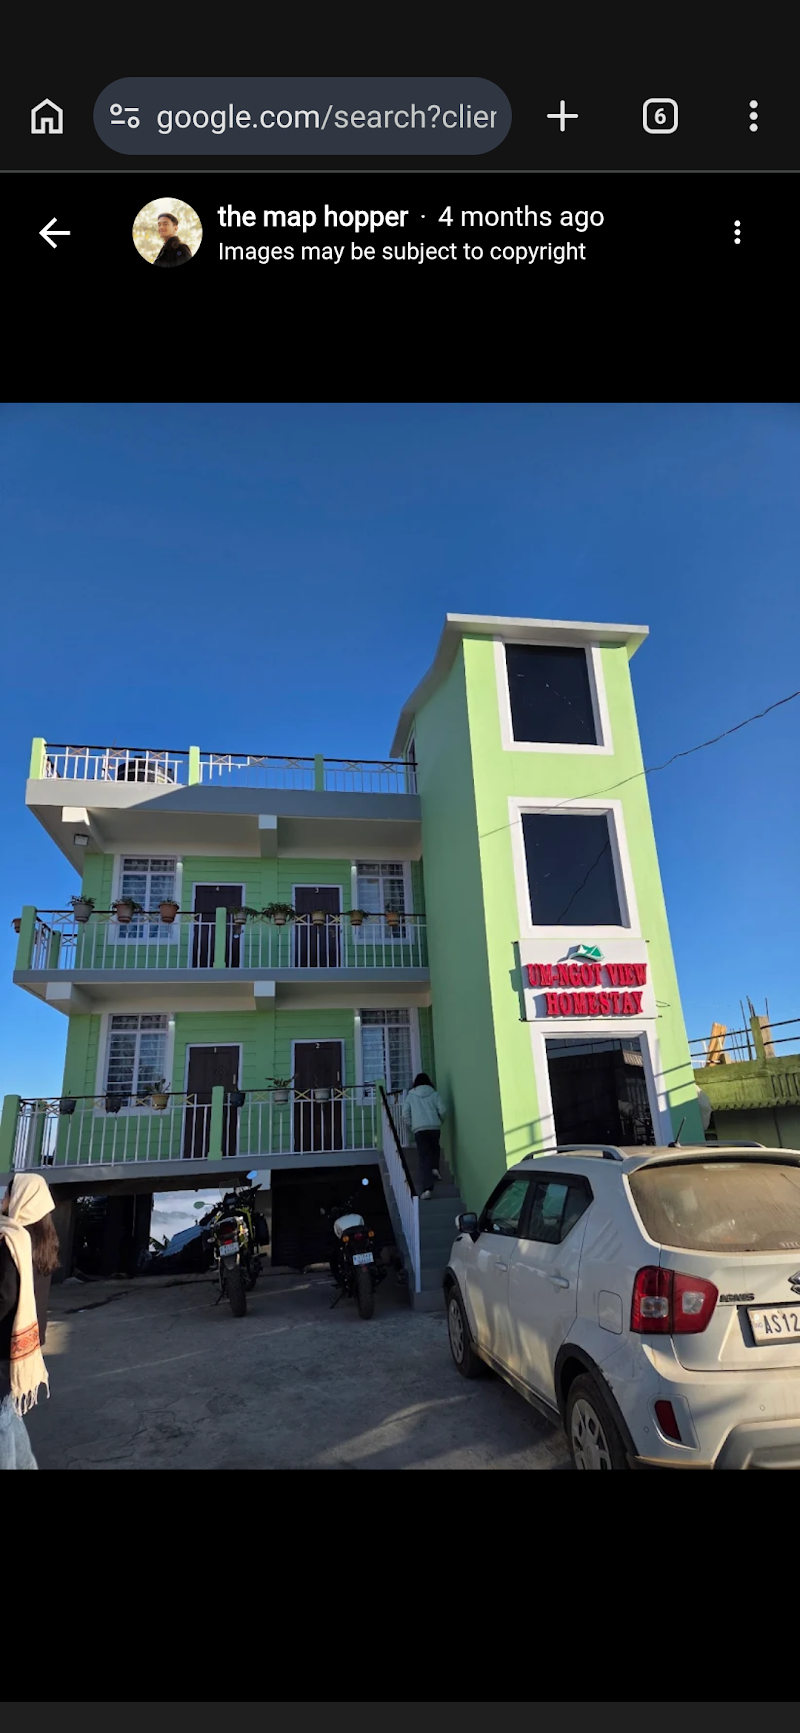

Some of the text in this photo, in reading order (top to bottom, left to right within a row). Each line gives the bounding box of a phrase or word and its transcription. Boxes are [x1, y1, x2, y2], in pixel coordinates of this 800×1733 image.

[526, 963, 648, 987] UM-NGOT VIEW
[545, 991, 643, 1015] HOMESTAY
